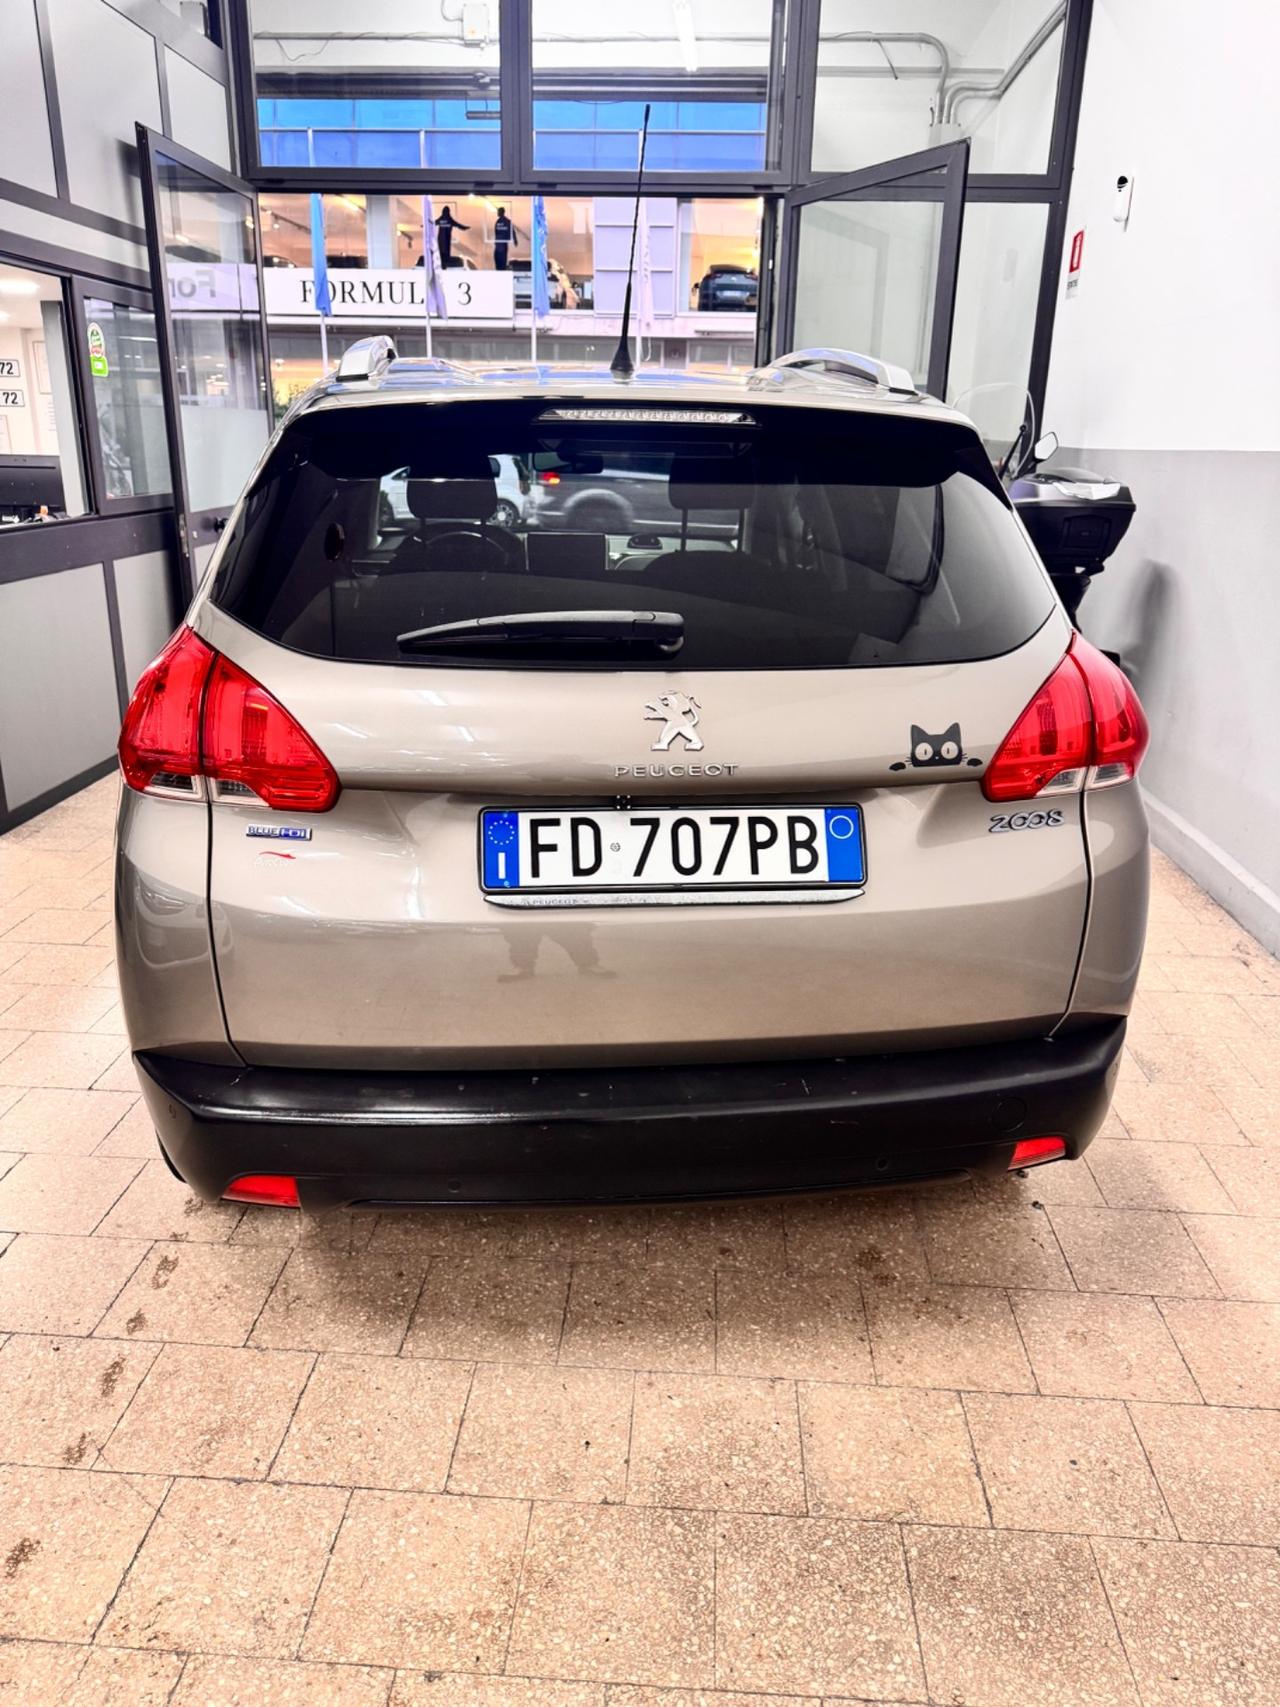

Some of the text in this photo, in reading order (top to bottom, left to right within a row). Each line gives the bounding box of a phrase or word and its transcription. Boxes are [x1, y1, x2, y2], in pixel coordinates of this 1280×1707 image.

[457, 281, 473, 306] 3
[2, 391, 19, 405] 72
[614, 763, 739, 777] PEUGEOT
[988, 808, 1065, 833] 2008
[498, 815, 819, 880] I FD 707PB
